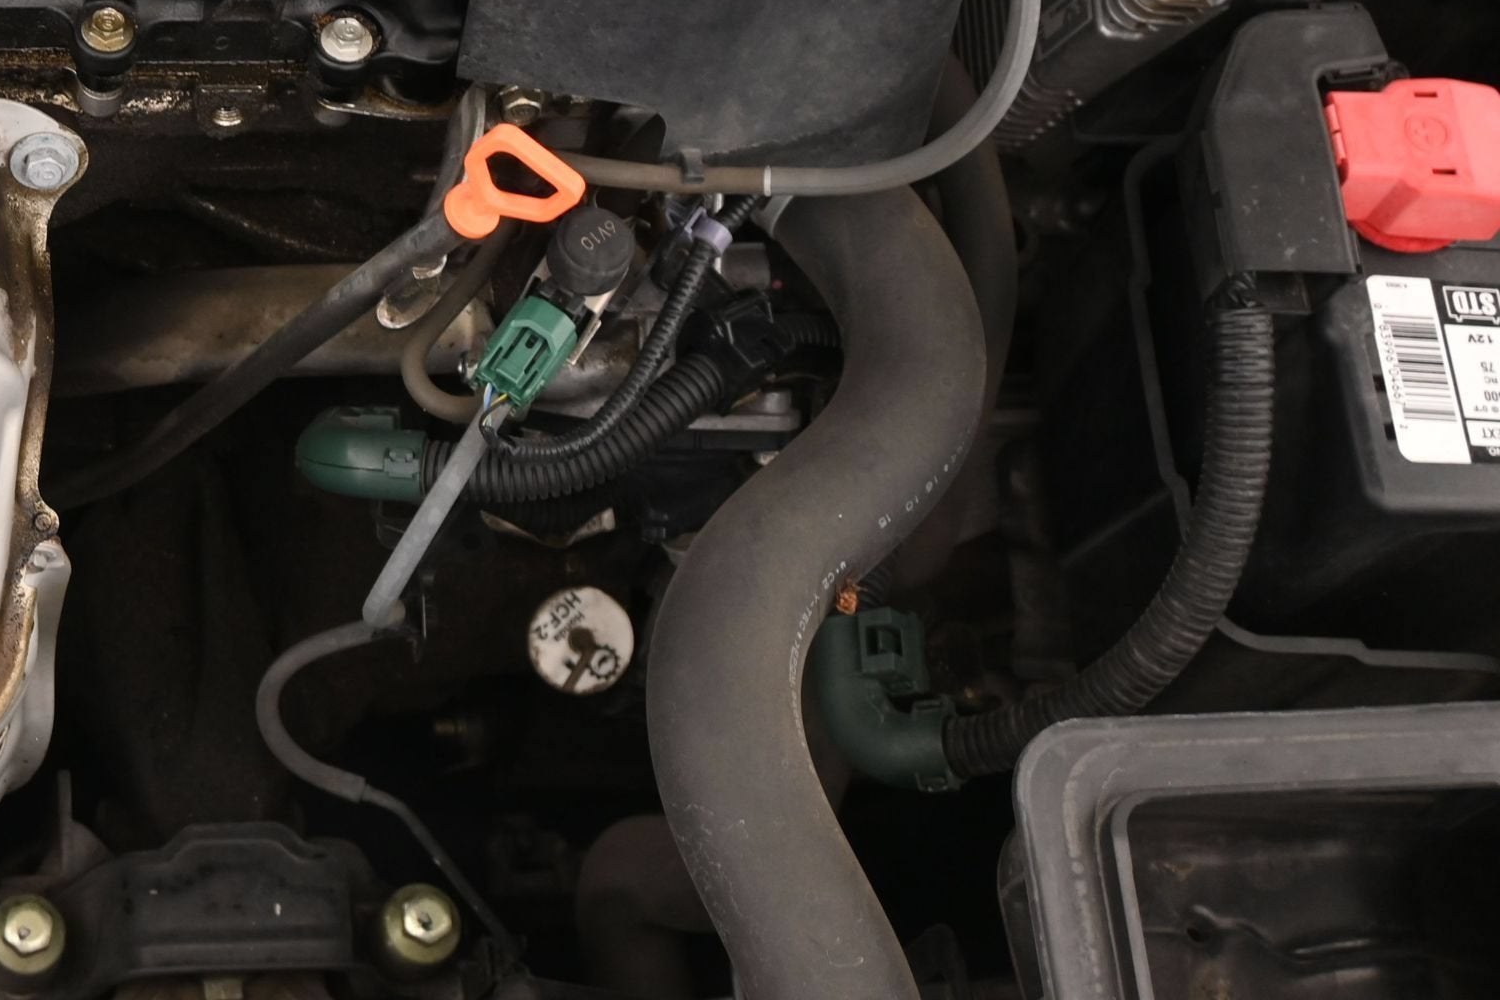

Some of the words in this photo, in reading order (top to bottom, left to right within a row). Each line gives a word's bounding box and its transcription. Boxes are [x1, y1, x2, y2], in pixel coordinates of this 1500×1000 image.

[1452, 290, 1498, 317] STD
[1467, 333, 1494, 345] 12V
[1480, 361, 1495, 373] 75
[533, 591, 582, 640] HCF-2
